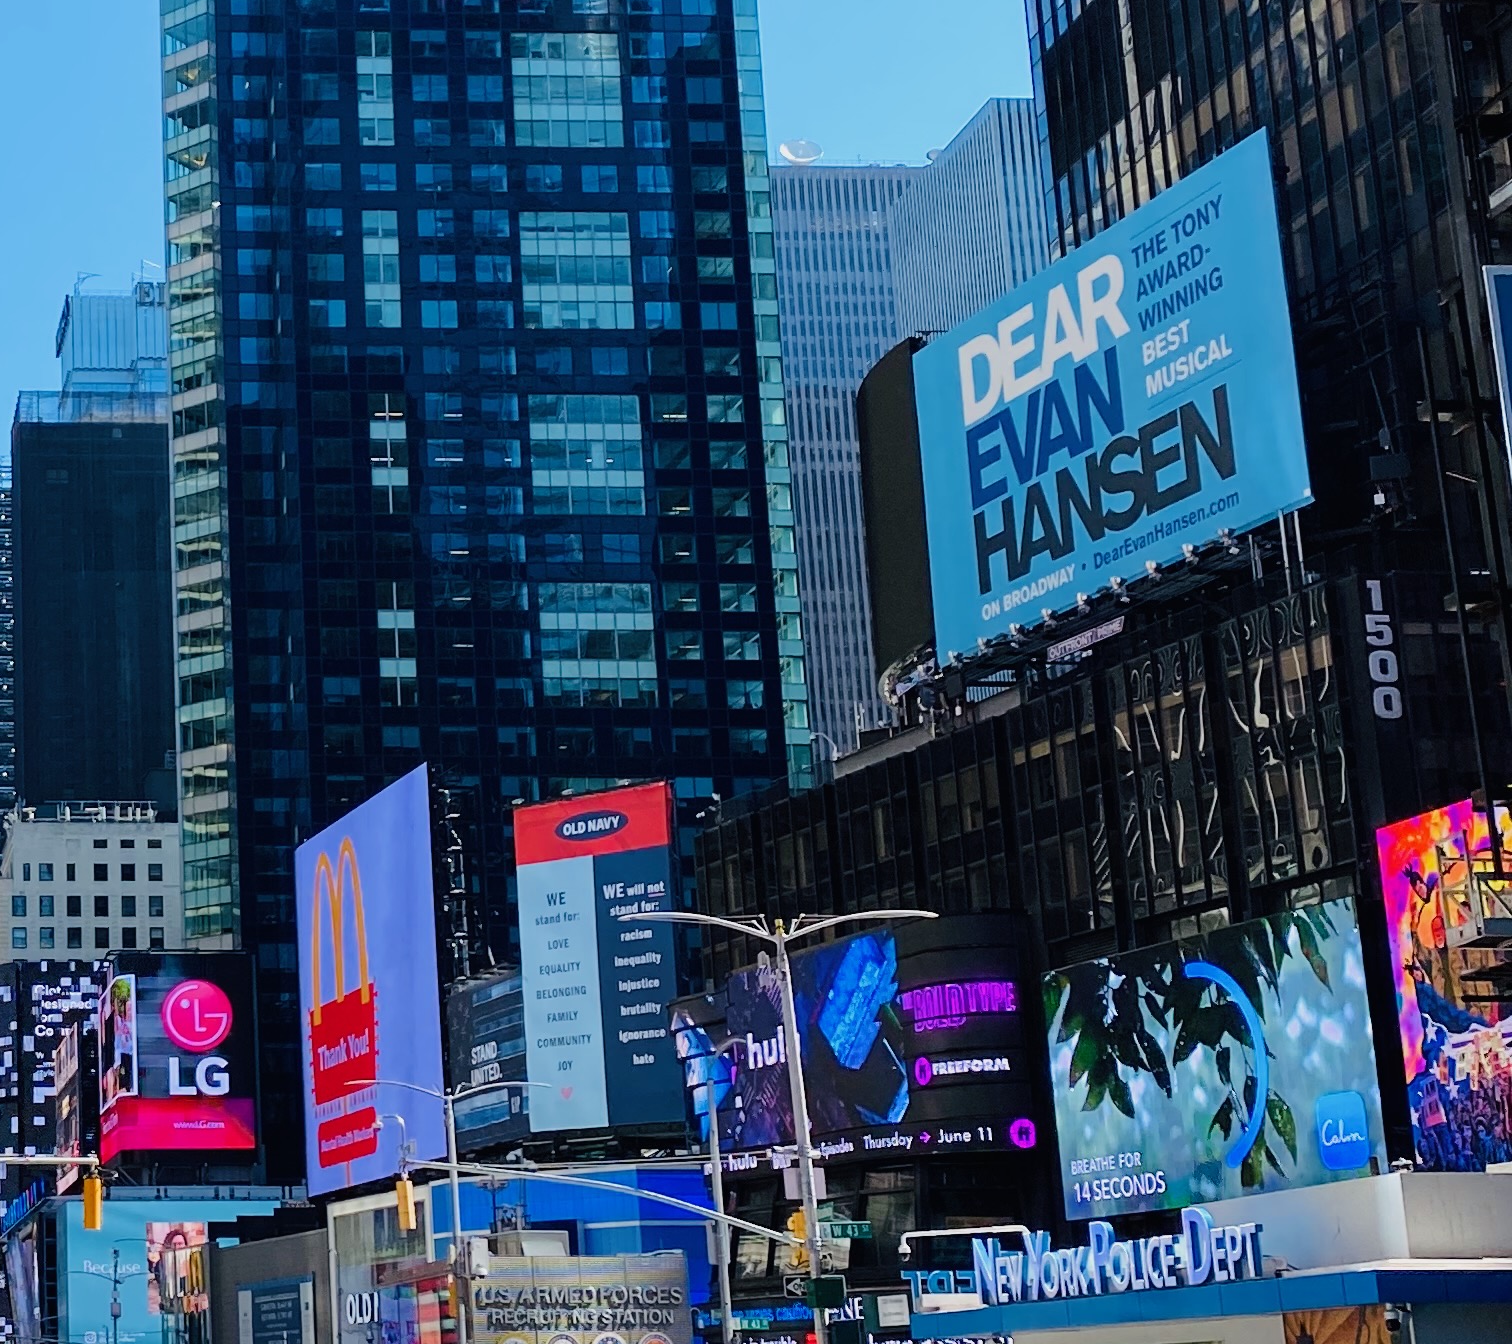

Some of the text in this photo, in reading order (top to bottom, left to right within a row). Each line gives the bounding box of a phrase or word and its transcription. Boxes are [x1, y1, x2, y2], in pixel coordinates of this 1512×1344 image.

[1131, 194, 1223, 269] THE TONY
[1136, 243, 1211, 303] AWARD-
[1138, 266, 1224, 332] WINNING
[958, 254, 1131, 427] DEAR
[1141, 318, 1191, 367] BEST
[1145, 333, 1233, 399] MUSICAL
[966, 344, 1125, 511] EVAN
[973, 382, 1238, 596] HANSEN
[981, 492, 1240, 621] ON BROADWAY DearEvanHansen.com
[1364, 579, 1403, 719] 1500
[562, 815, 620, 837] OLD NAVY
[546, 891, 567, 907] WE
[602, 881, 665, 900] WE will not
[535, 911, 581, 926] stand for:
[610, 901, 660, 917] stand for:
[547, 938, 570, 951] LOVE
[620, 928, 653, 942] racism
[539, 961, 581, 976] EQUALITY
[614, 951, 662, 968] inequality
[536, 985, 588, 1000] BELONGING
[618, 977, 660, 992] injustice
[966, 981, 1017, 1012] TYPE
[547, 1010, 579, 1024] FAMILY
[620, 1002, 662, 1017] brutality
[537, 1034, 592, 1049] COMMUNITY
[618, 1028, 667, 1044] ignorance
[317, 1027, 370, 1072] Thank You!
[470, 1040, 498, 1066] STAND
[633, 1054, 655, 1066] hate
[168, 1056, 230, 1096] LG
[470, 1062, 503, 1087] UNITED.
[557, 1060, 574, 1072] JOY
[932, 1058, 1011, 1076] FREEFORM
[862, 1126, 993, 1151] Thursday June 11
[1321, 1118, 1366, 1147] Calm
[728, 1153, 758, 1172] hulu
[1071, 1151, 1142, 1176] BREATHE FOR
[1072, 1170, 1167, 1204] 14 SECONDS
[831, 1225, 843, 1238] W
[846, 1224, 859, 1237] 43
[972, 1207, 1264, 1306] NEW YORK POLICE DEPT
[480, 1285, 683, 1305] U.S. ARMED FORCES
[346, 1293, 372, 1325] OLD
[491, 1308, 675, 1325] RECRUITNG STATION
[751, 1318, 762, 1329] 43
